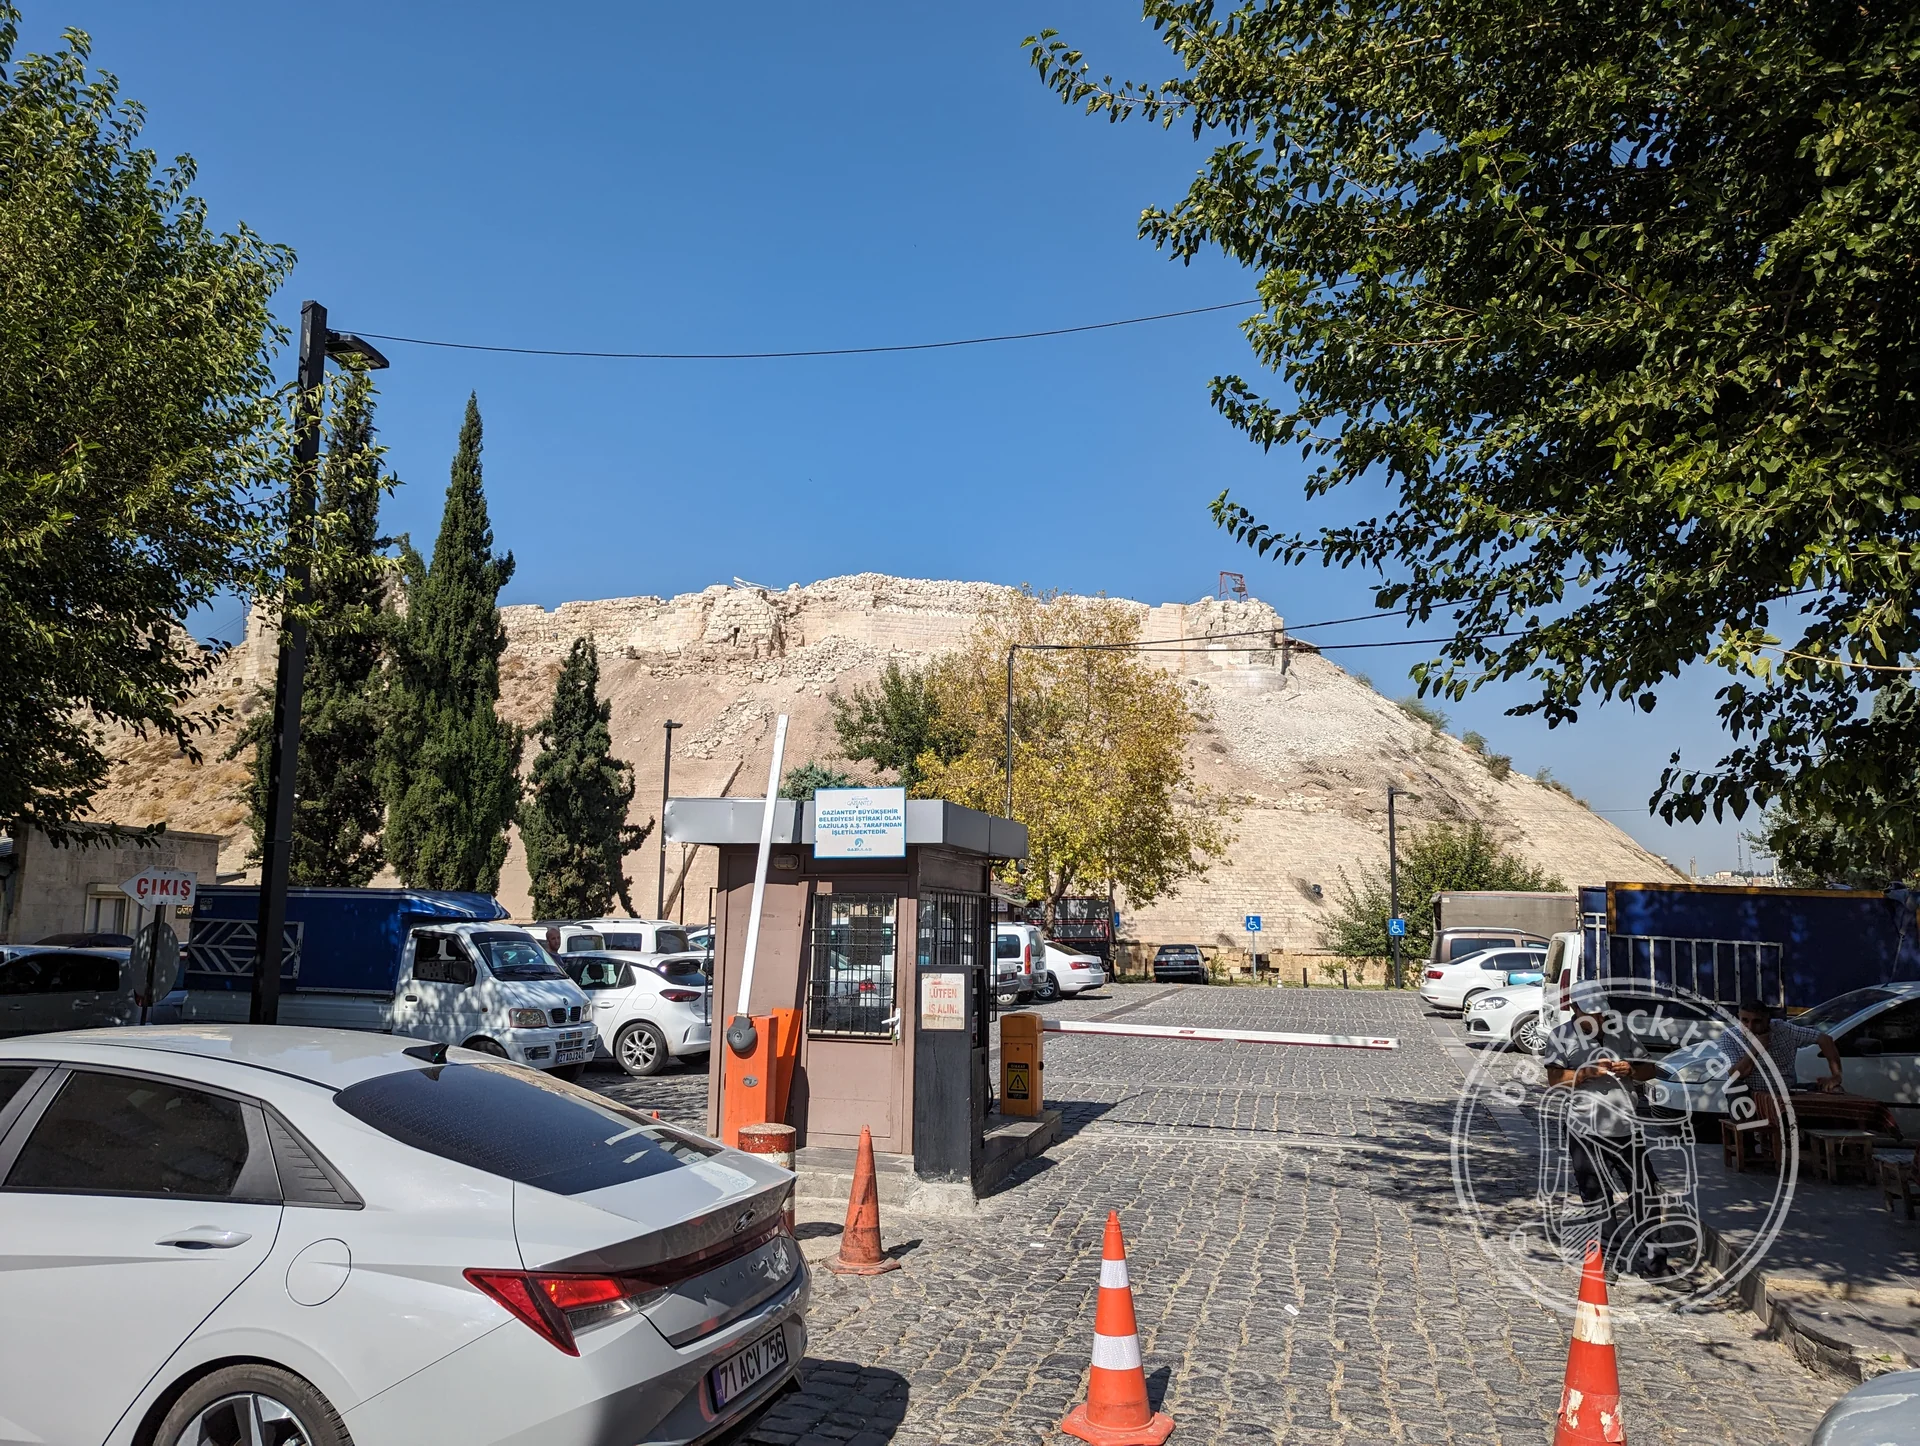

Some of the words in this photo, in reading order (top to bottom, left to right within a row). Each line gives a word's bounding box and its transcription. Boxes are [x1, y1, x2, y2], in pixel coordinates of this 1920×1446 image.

[857, 808, 899, 816] BÜYÜKŞEHİR
[818, 815, 855, 823] BELEDİYESİ
[855, 814, 883, 822] İŞTİRAKİ
[831, 828, 888, 836] İŞLETİLMEKTEDİR.
[136, 877, 192, 901] ÇIKIŞ
[719, 1362, 738, 1399] 71
[738, 1345, 762, 1388] ACV
[761, 1331, 786, 1370] 756
